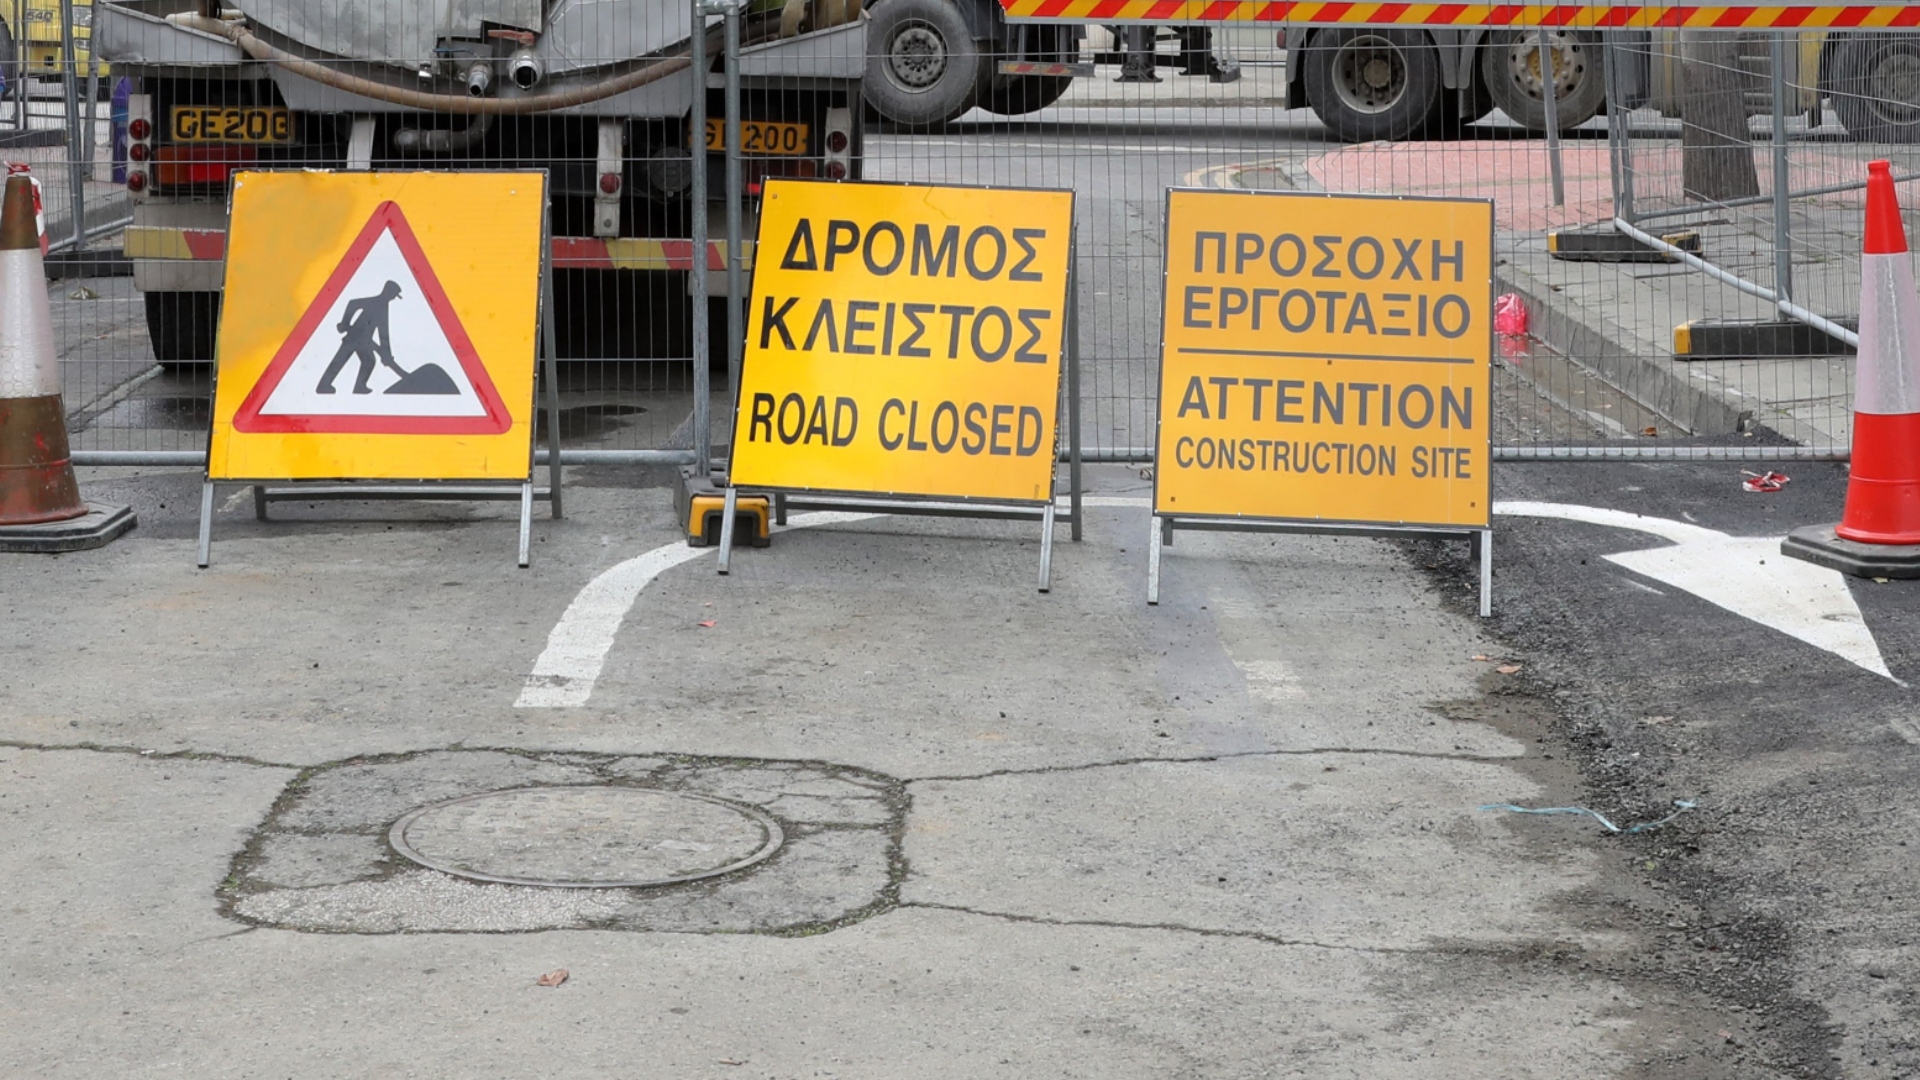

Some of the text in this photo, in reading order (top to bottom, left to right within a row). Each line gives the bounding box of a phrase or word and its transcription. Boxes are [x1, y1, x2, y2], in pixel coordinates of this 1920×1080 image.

[779, 217, 1047, 282] ΔΡΟΜΟΣ
[1193, 230, 1464, 283] ΠΡΟΣΟΧΗ
[759, 295, 1052, 364] ΚΛΕΙΣΤΟΣ
[1182, 285, 1471, 340] ΕΡΓΟΤΑΞΙΟ
[748, 392, 1043, 457] ROAD CLOSED
[1177, 375, 1473, 430] ATTENTION
[1175, 435, 1472, 480] CONSTRUCTION SITE
